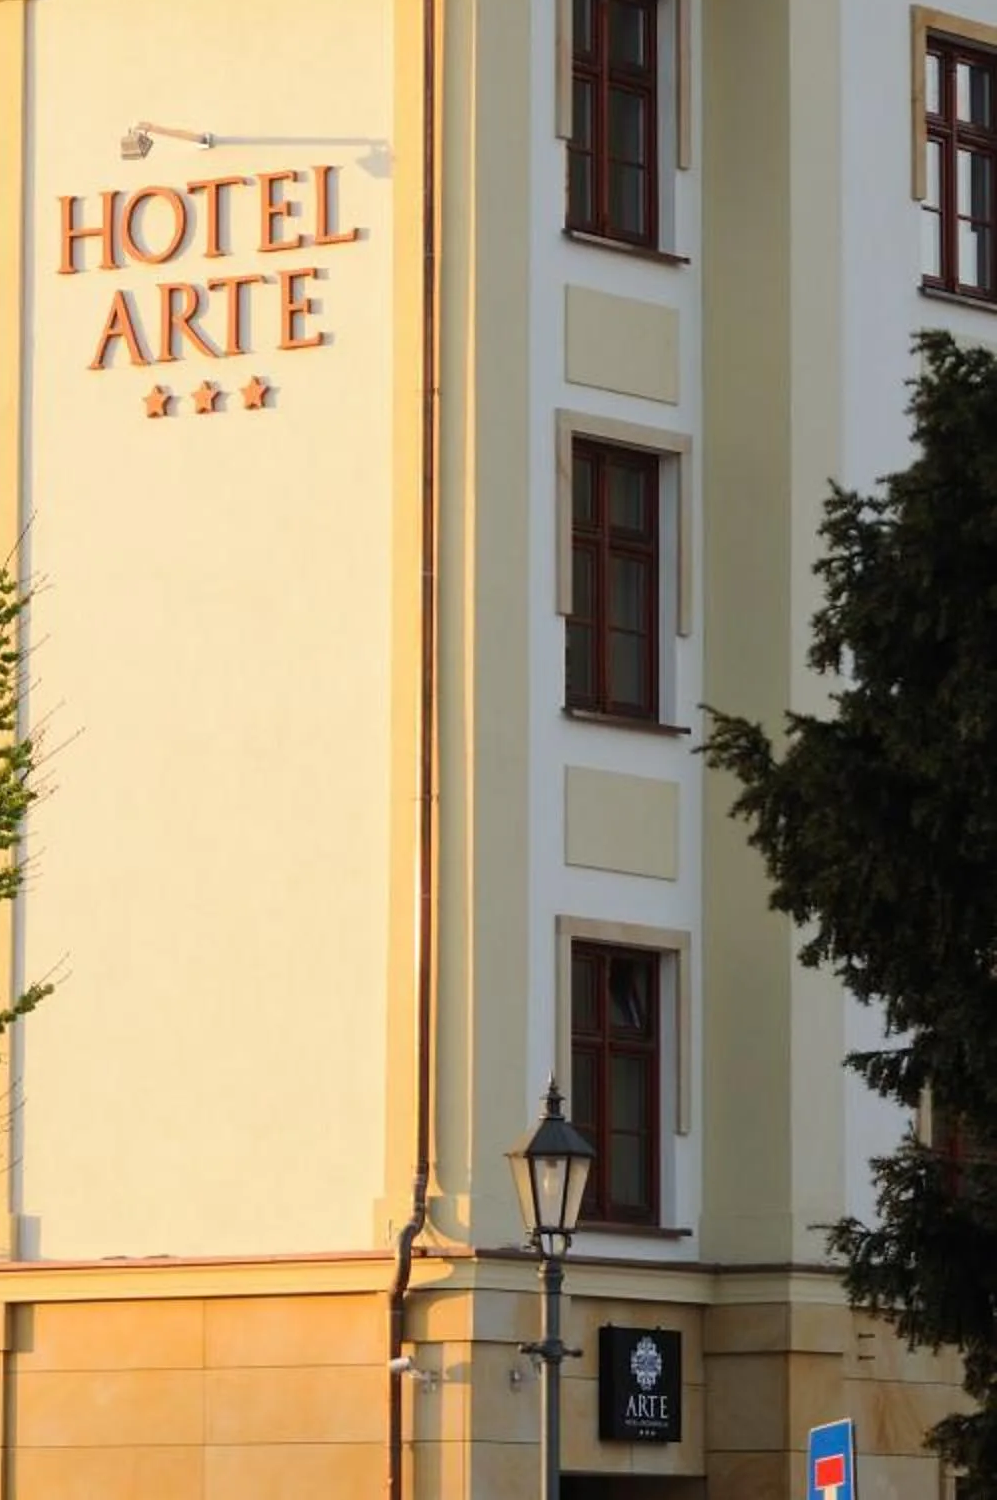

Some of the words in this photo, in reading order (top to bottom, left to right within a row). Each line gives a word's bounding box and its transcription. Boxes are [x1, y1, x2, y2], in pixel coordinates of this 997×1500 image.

[57, 166, 361, 274] HOTEL
[87, 267, 325, 370] ARTE
[626, 1394, 669, 1419] ARTE
